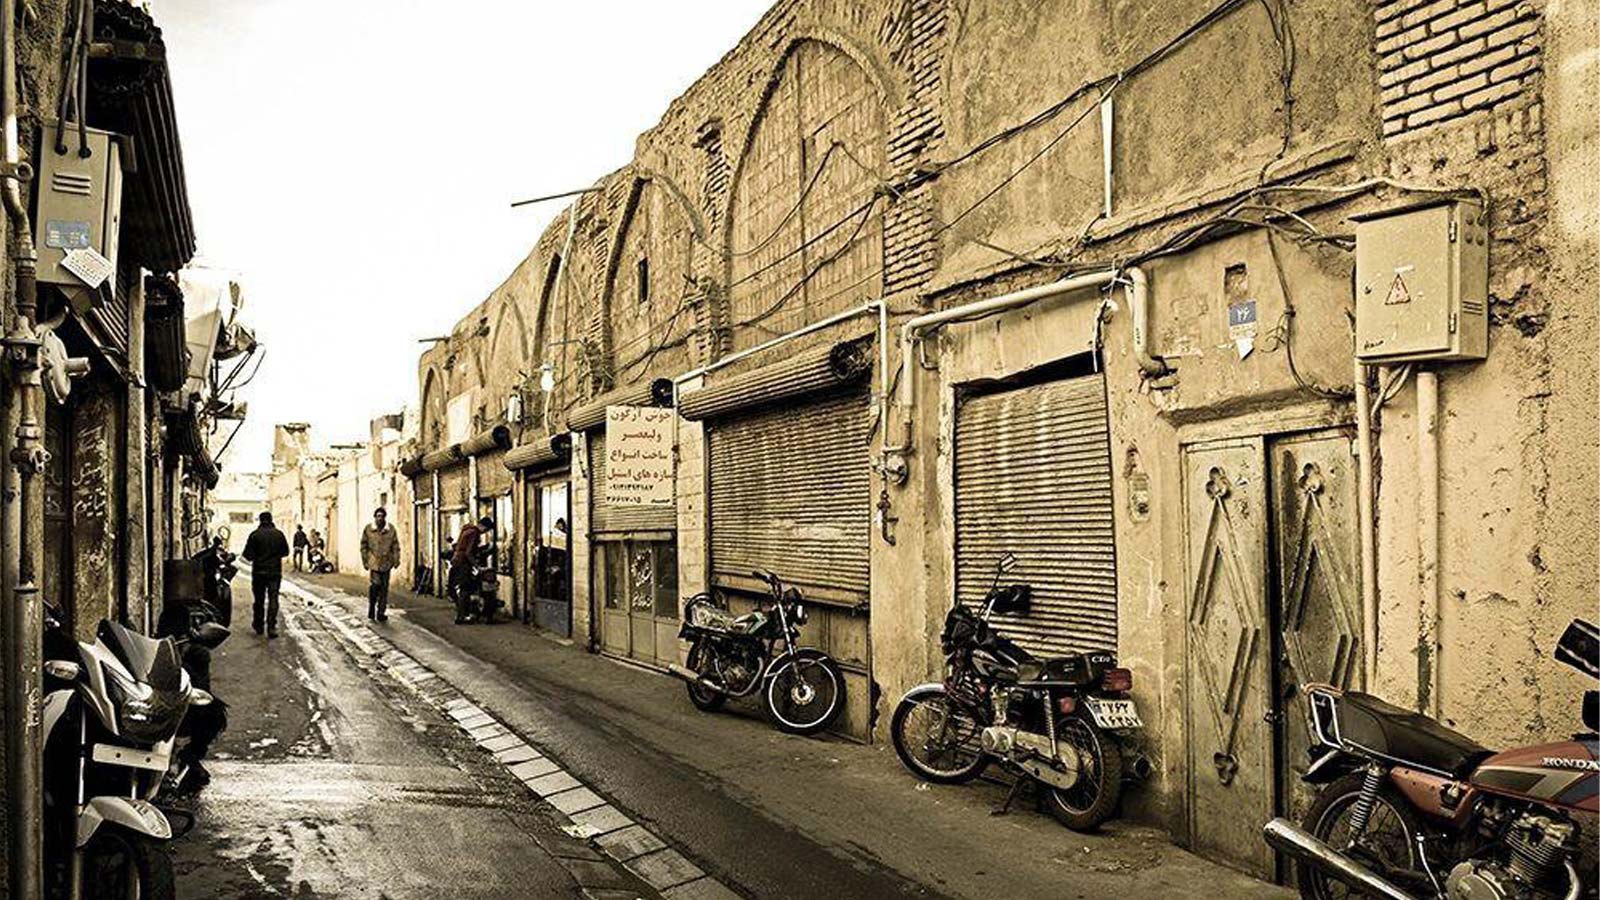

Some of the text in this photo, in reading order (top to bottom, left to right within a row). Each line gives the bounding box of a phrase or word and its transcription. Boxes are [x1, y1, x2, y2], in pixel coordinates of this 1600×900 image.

[645, 410, 671, 423] جوش
[610, 449, 668, 462] ساخت انواع
[607, 468, 632, 481] استیل
[632, 469, 651, 481] های
[1541, 756, 1599, 770] HONDA
